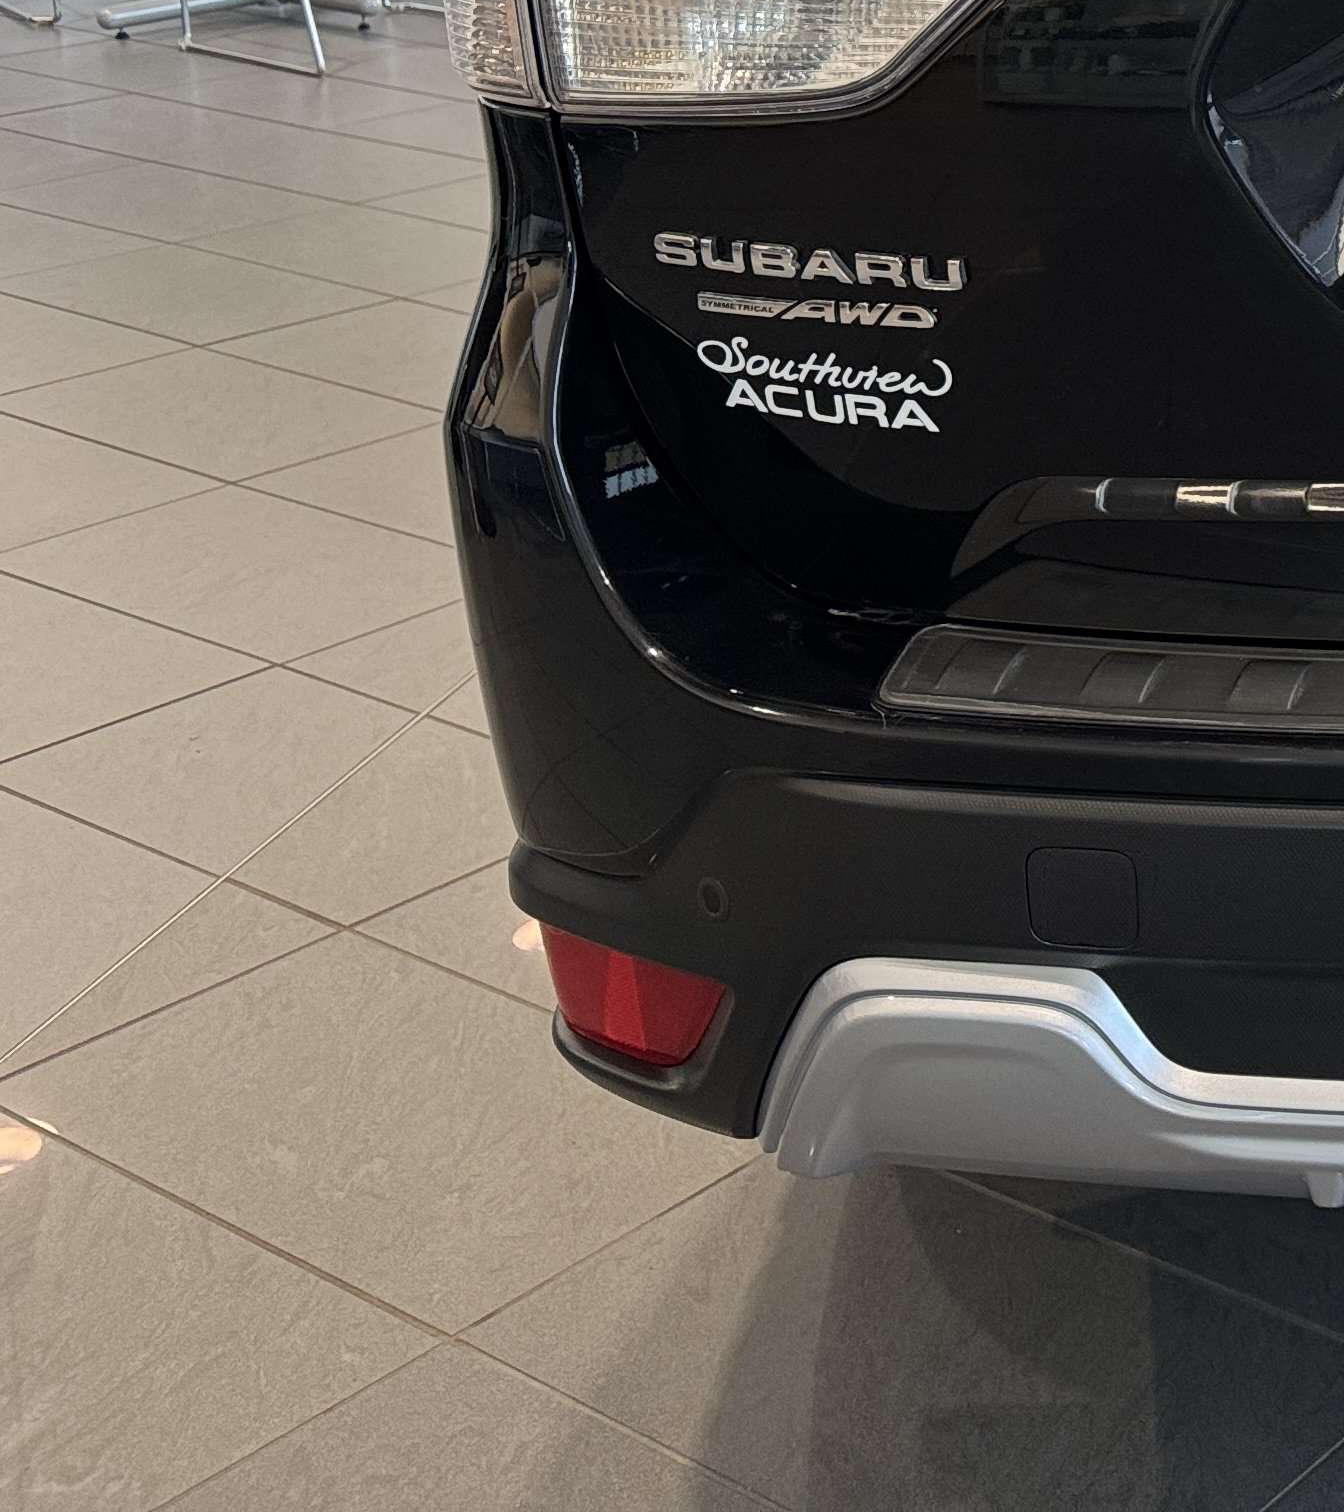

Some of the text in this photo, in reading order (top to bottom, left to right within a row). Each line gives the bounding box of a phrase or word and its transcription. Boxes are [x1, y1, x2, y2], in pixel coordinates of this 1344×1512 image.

[653, 230, 968, 291] SUBARU
[701, 298, 936, 329] SYMMETRICAL AWD
[696, 336, 953, 397] Southview
[725, 378, 941, 433] ACURA
